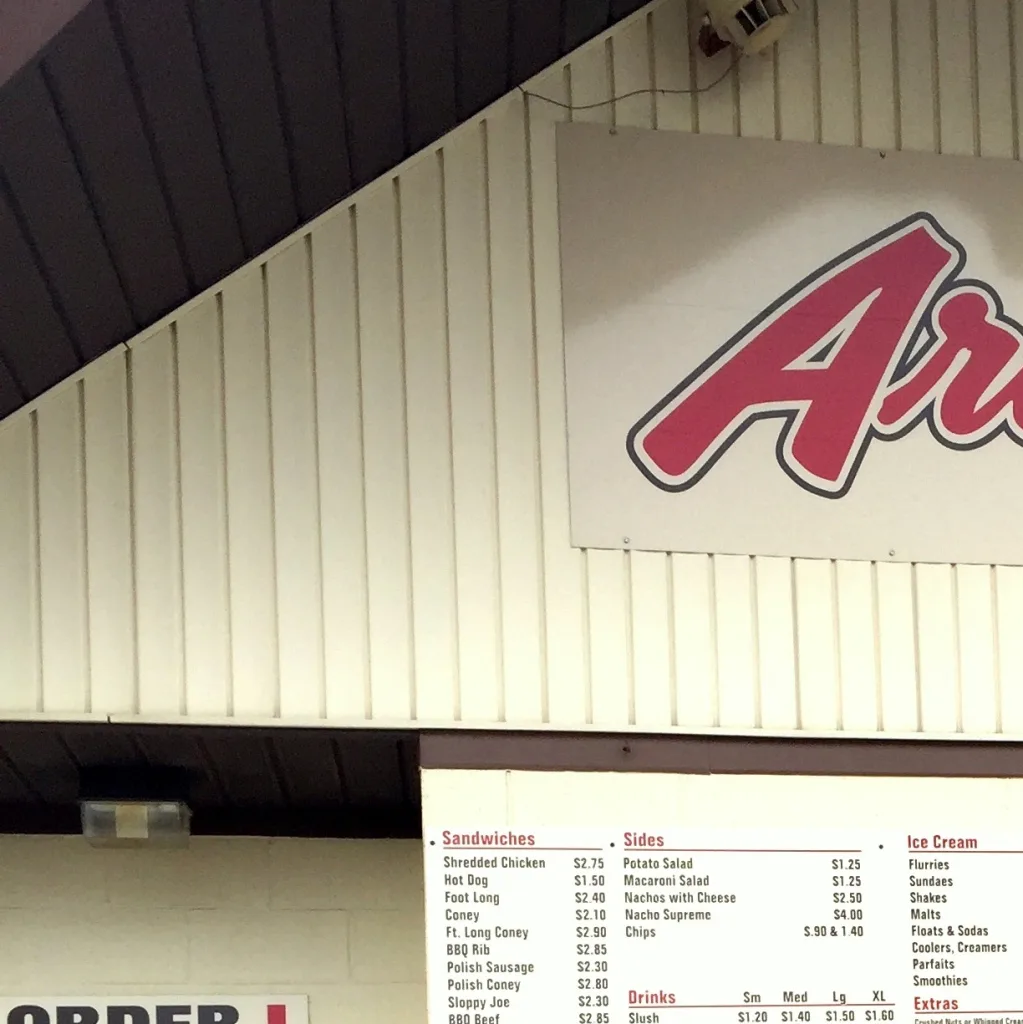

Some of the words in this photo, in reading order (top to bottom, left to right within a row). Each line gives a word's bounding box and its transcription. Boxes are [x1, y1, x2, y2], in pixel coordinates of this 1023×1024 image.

[443, 831, 535, 845] Sandwiches
[624, 832, 664, 846] Sides
[908, 835, 928, 848] Ice
[933, 835, 977, 849] Cream
[444, 856, 497, 868] Shredded
[502, 857, 545, 868] Chicken
[574, 858, 604, 869] $2.75
[909, 859, 949, 870] Flurries
[445, 874, 463, 885] Hot
[468, 874, 488, 888] Dog
[575, 875, 604, 886] $1.50
[624, 875, 675, 886] Macaroni
[680, 875, 709, 886] Salad
[833, 876, 861, 886] $1.25
[625, 892, 665, 903] Nachos
[669, 892, 693, 903] with
[698, 892, 736, 903] Cheese
[833, 893, 862, 903] $2.50
[912, 925, 943, 936] Floats
[947, 926, 954, 936] &
[958, 925, 988, 936] Sodas
[448, 961, 482, 973] Polish
[486, 961, 534, 975] Sausage
[577, 961, 607, 972] $2.30
[448, 996, 483, 1010] Sloppy
[490, 996, 509, 1007] Joe
[579, 996, 608, 1007] $2.30
[629, 990, 675, 1004] Drinks
[744, 992, 760, 1003] Sm
[783, 991, 807, 1002] Med
[831, 991, 847, 1006] Lg
[873, 991, 885, 1001] XL
[914, 997, 960, 1012] Extras
